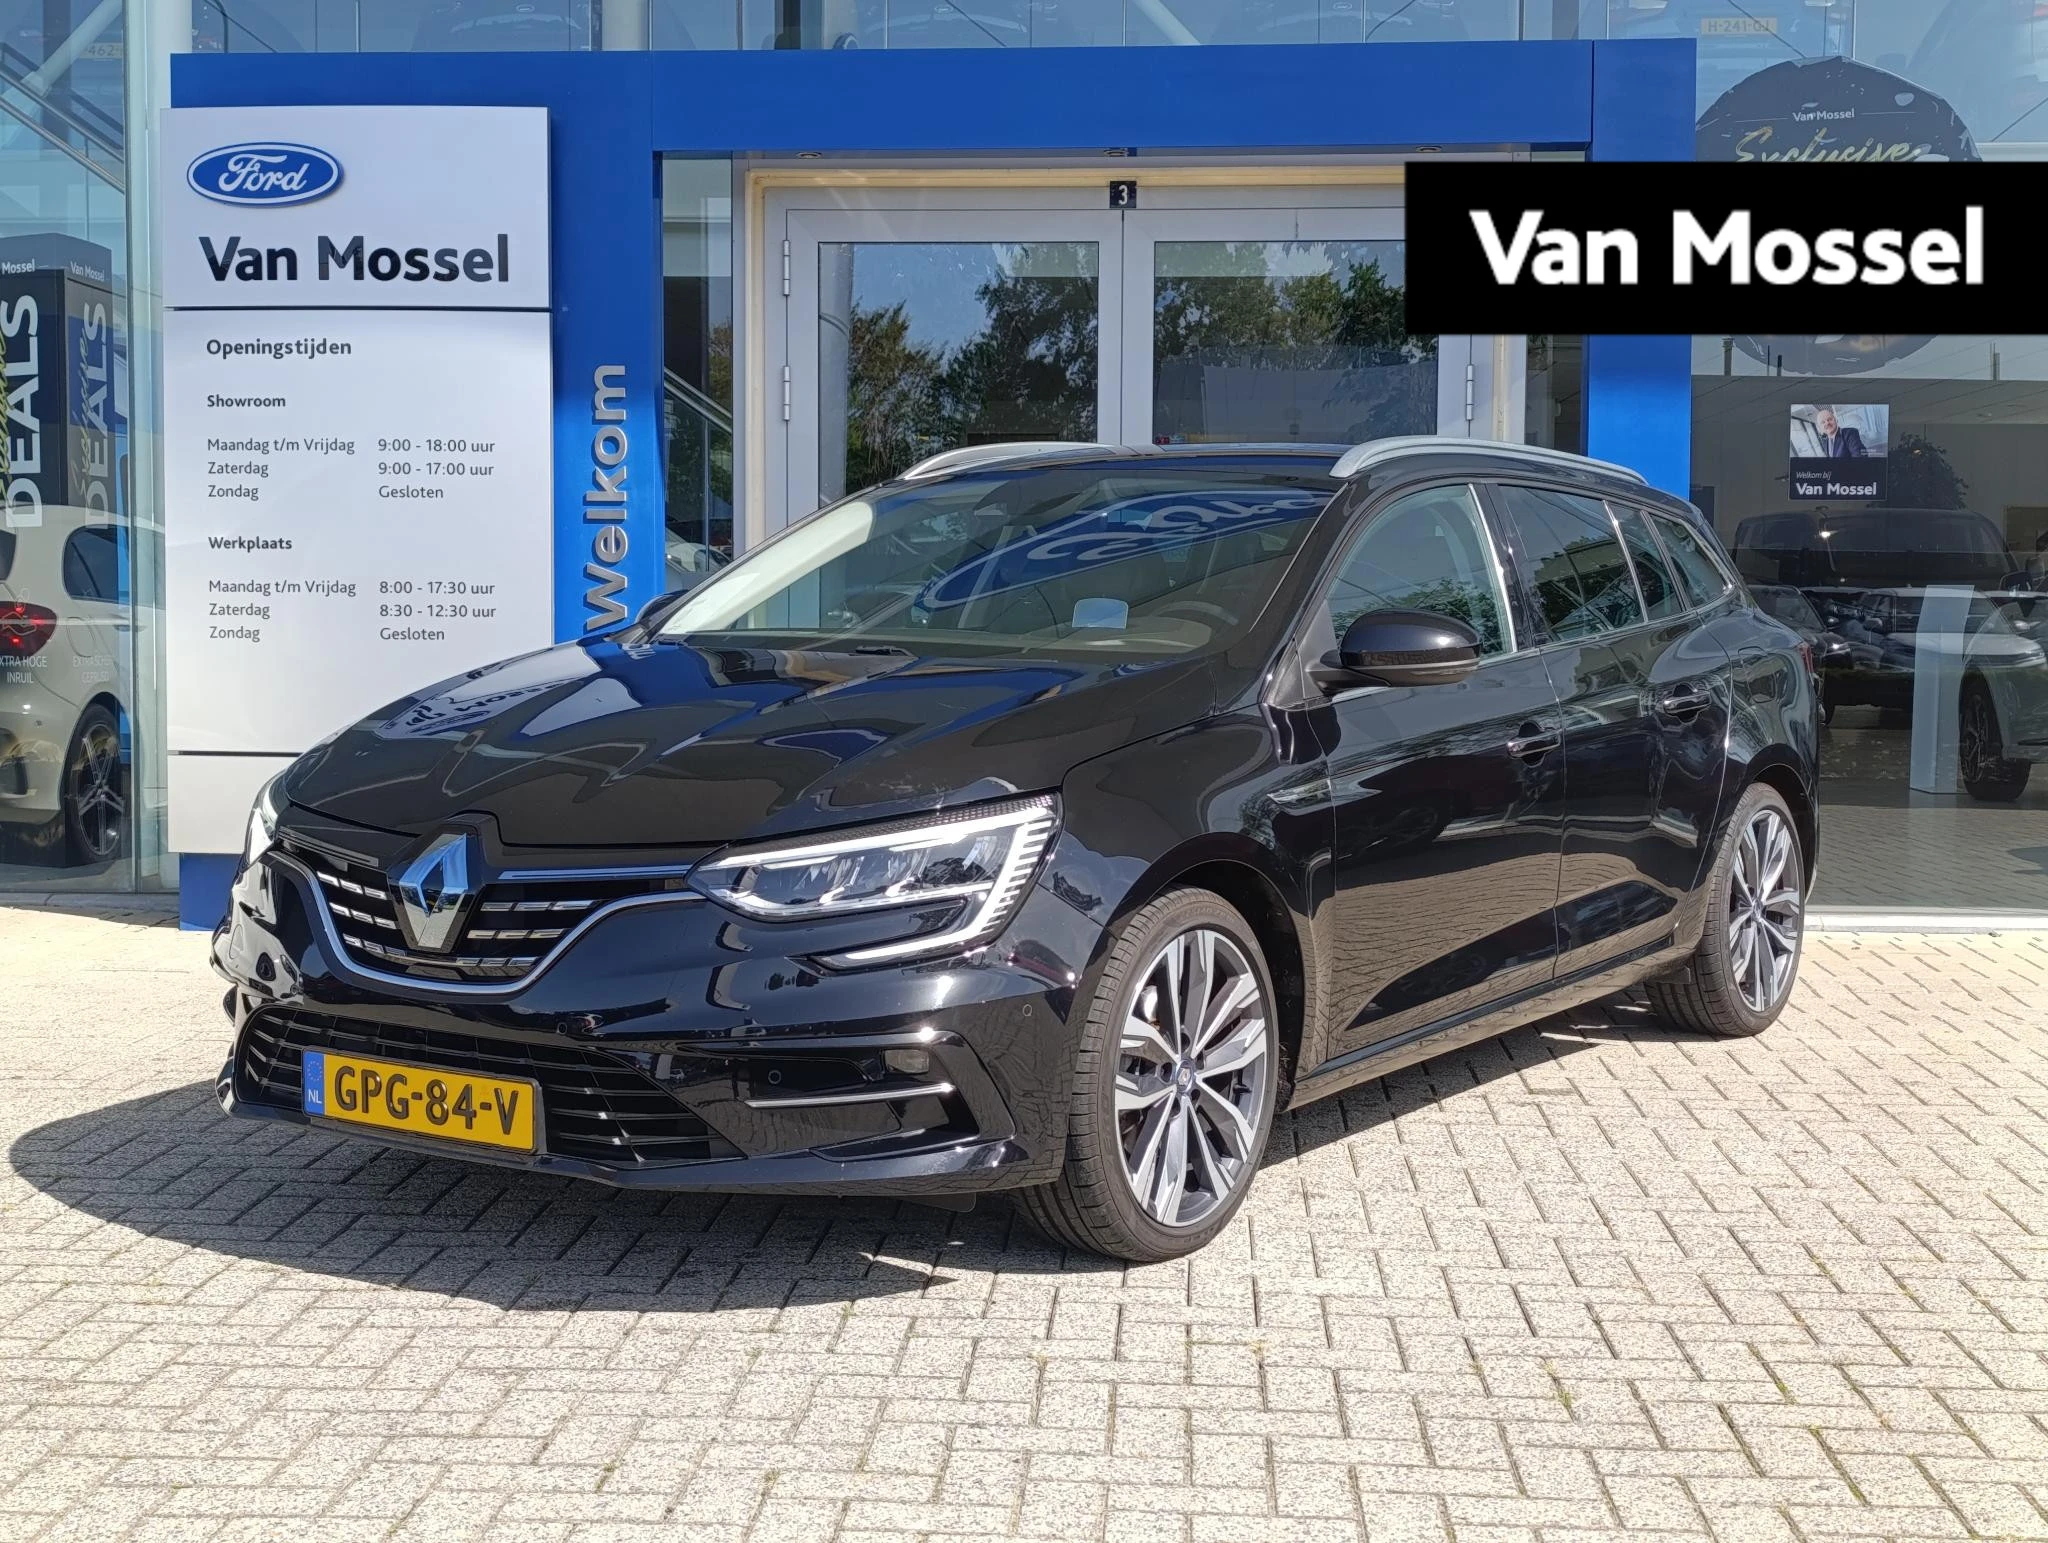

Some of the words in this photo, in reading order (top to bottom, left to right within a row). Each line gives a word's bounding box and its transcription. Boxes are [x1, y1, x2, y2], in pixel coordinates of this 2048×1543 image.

[1792, 111, 1815, 122] Van
[1816, 108, 1855, 121] Mossel
[218, 153, 309, 192] Ford
[1118, 184, 1128, 205] 3
[1, 258, 35, 275] Mossel
[199, 236, 297, 282] Van
[318, 234, 508, 283] Mossel
[70, 261, 83, 276] Van
[85, 264, 105, 281] Mossel
[207, 337, 352, 360] Openingstijden
[207, 394, 287, 408] Showroom
[1, 294, 43, 528] DEALS
[83, 302, 109, 530] DEALS
[208, 438, 269, 456] Maandag
[273, 438, 300, 452] t/m
[304, 438, 355, 456] Vrijdag
[378, 439, 410, 452] 9:00
[427, 439, 466, 452] 18:00
[471, 443, 495, 452] uur
[208, 461, 268, 478] Zaterdag
[378, 462, 411, 475] 9:00
[427, 462, 465, 475] 17:00
[470, 467, 494, 475] uur
[1796, 471, 1822, 479] Welkom
[1823, 471, 1832, 480] bij
[208, 484, 259, 501] Zondag
[379, 485, 444, 499] Gesloten
[585, 364, 629, 631] Welkom
[1796, 482, 1822, 496] Van
[1827, 482, 1877, 496] Mossel
[208, 535, 293, 554] Werkplaats
[209, 580, 271, 597] Maandag
[275, 580, 301, 594] t/m
[305, 580, 356, 597] Vrijdag
[379, 581, 412, 594] 8:00
[428, 581, 466, 594] 17:30
[471, 585, 495, 594] uur
[210, 603, 270, 620] Zaterdag
[380, 604, 412, 617] 8:30
[427, 604, 467, 617] 12:30
[473, 608, 496, 617] uur
[210, 626, 260, 643] Zondag
[380, 626, 444, 641] Gesloten
[22, 655, 48, 668] HOGE
[7, 671, 34, 684] INRUIL
[308, 1089, 322, 1104] NL
[334, 1065, 519, 1135] GPG-84-V
